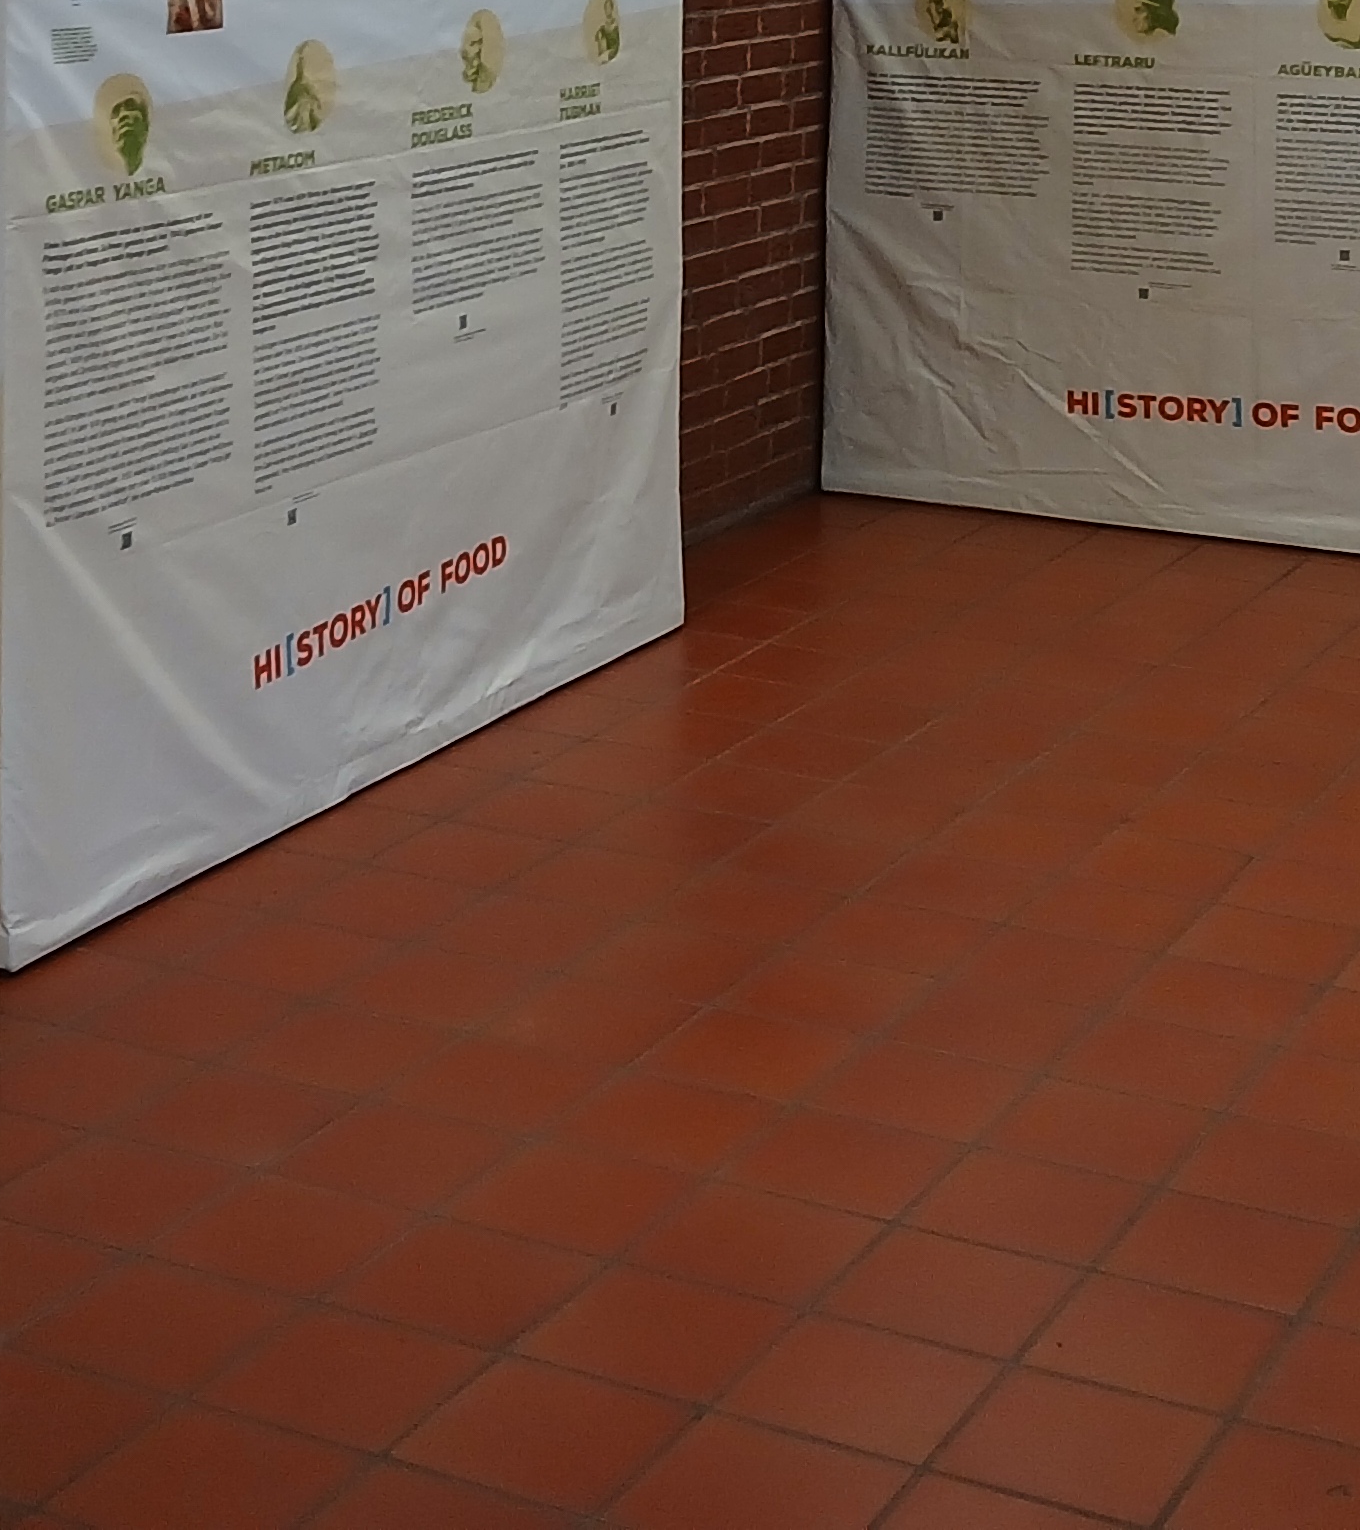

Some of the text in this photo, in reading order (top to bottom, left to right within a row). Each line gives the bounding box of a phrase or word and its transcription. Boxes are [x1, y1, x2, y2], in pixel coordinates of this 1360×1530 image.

[1074, 53, 1156, 70] LEFTRARU
[411, 102, 473, 127] FREDERICK
[410, 122, 473, 150] DOUGLASS
[249, 149, 316, 177] METACOM
[45, 177, 166, 214] GASPAR YANGA
[1066, 388, 1244, 428] HI[STORY]
[1251, 399, 1301, 430] OF
[252, 535, 509, 690] HI[STORY] OF FOOD
